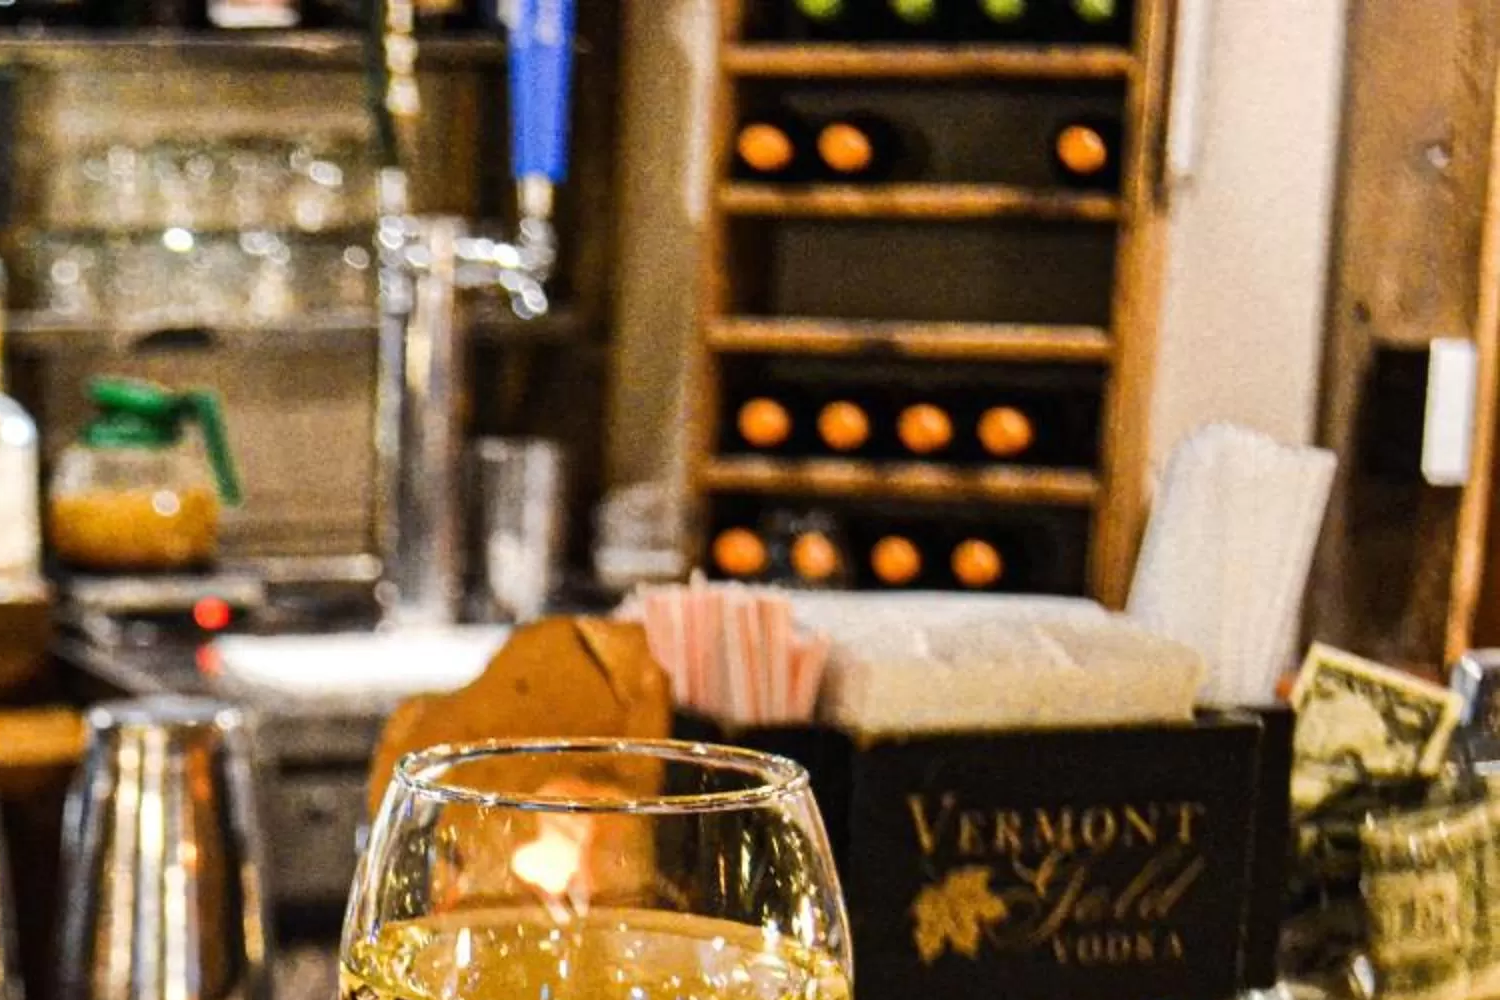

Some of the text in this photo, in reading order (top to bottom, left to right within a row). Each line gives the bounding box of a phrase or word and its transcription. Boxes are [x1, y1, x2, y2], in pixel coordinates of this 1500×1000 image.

[907, 792, 1206, 854] VERMONT
[989, 847, 1207, 949] Gold
[1051, 932, 1186, 965] VODKA
